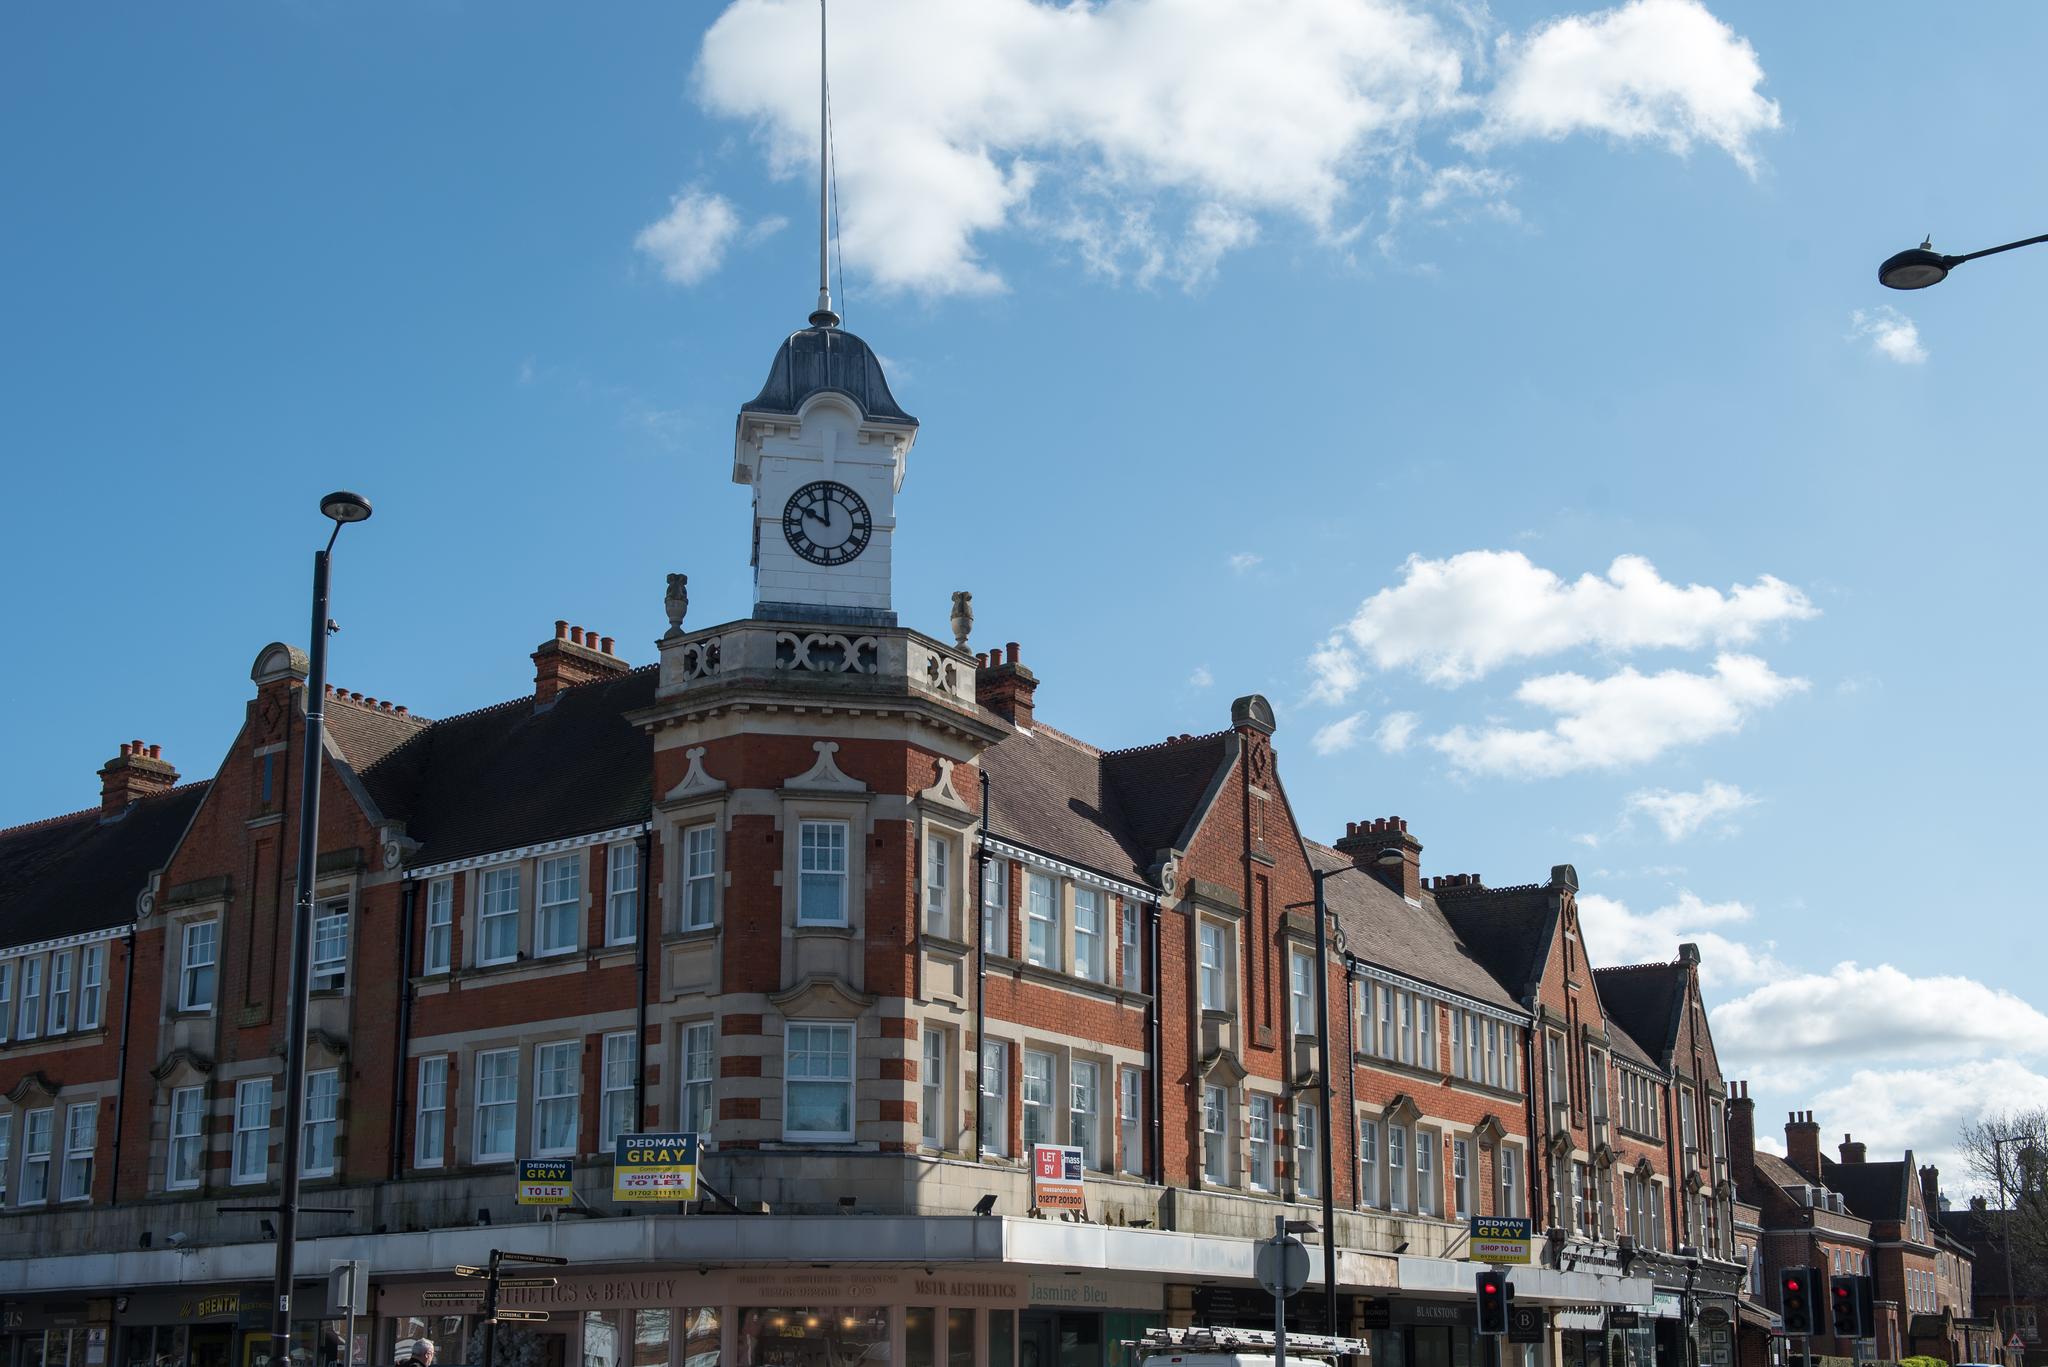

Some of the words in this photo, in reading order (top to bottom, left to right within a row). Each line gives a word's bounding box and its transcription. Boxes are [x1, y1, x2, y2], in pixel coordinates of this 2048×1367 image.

[626, 1138, 687, 1148] DEDMAN
[627, 1149, 686, 1162] GRAY
[1042, 1151, 1056, 1163] LET
[1064, 1156, 1081, 1165] mass
[527, 1169, 566, 1179] GRAY
[1044, 1165, 1054, 1175] BY
[528, 1187, 542, 1196] TO
[544, 1187, 564, 1196] LET
[1038, 1194, 1058, 1203] 01277
[1058, 1195, 1082, 1205] 201300
[1477, 1219, 1524, 1228] DEDMAN
[1478, 1226, 1523, 1238] GRAY
[585, 1285, 597, 1301] &
[604, 1279, 677, 1301] BEAUTY
[915, 1280, 947, 1295] MSTR
[949, 1281, 1017, 1298] AESTHETICS
[1031, 1282, 1078, 1302] Jasmine
[1083, 1285, 1108, 1303] Bleu
[1416, 1305, 1459, 1319] BLACKSTONE
[1520, 1315, 1530, 1326] B
